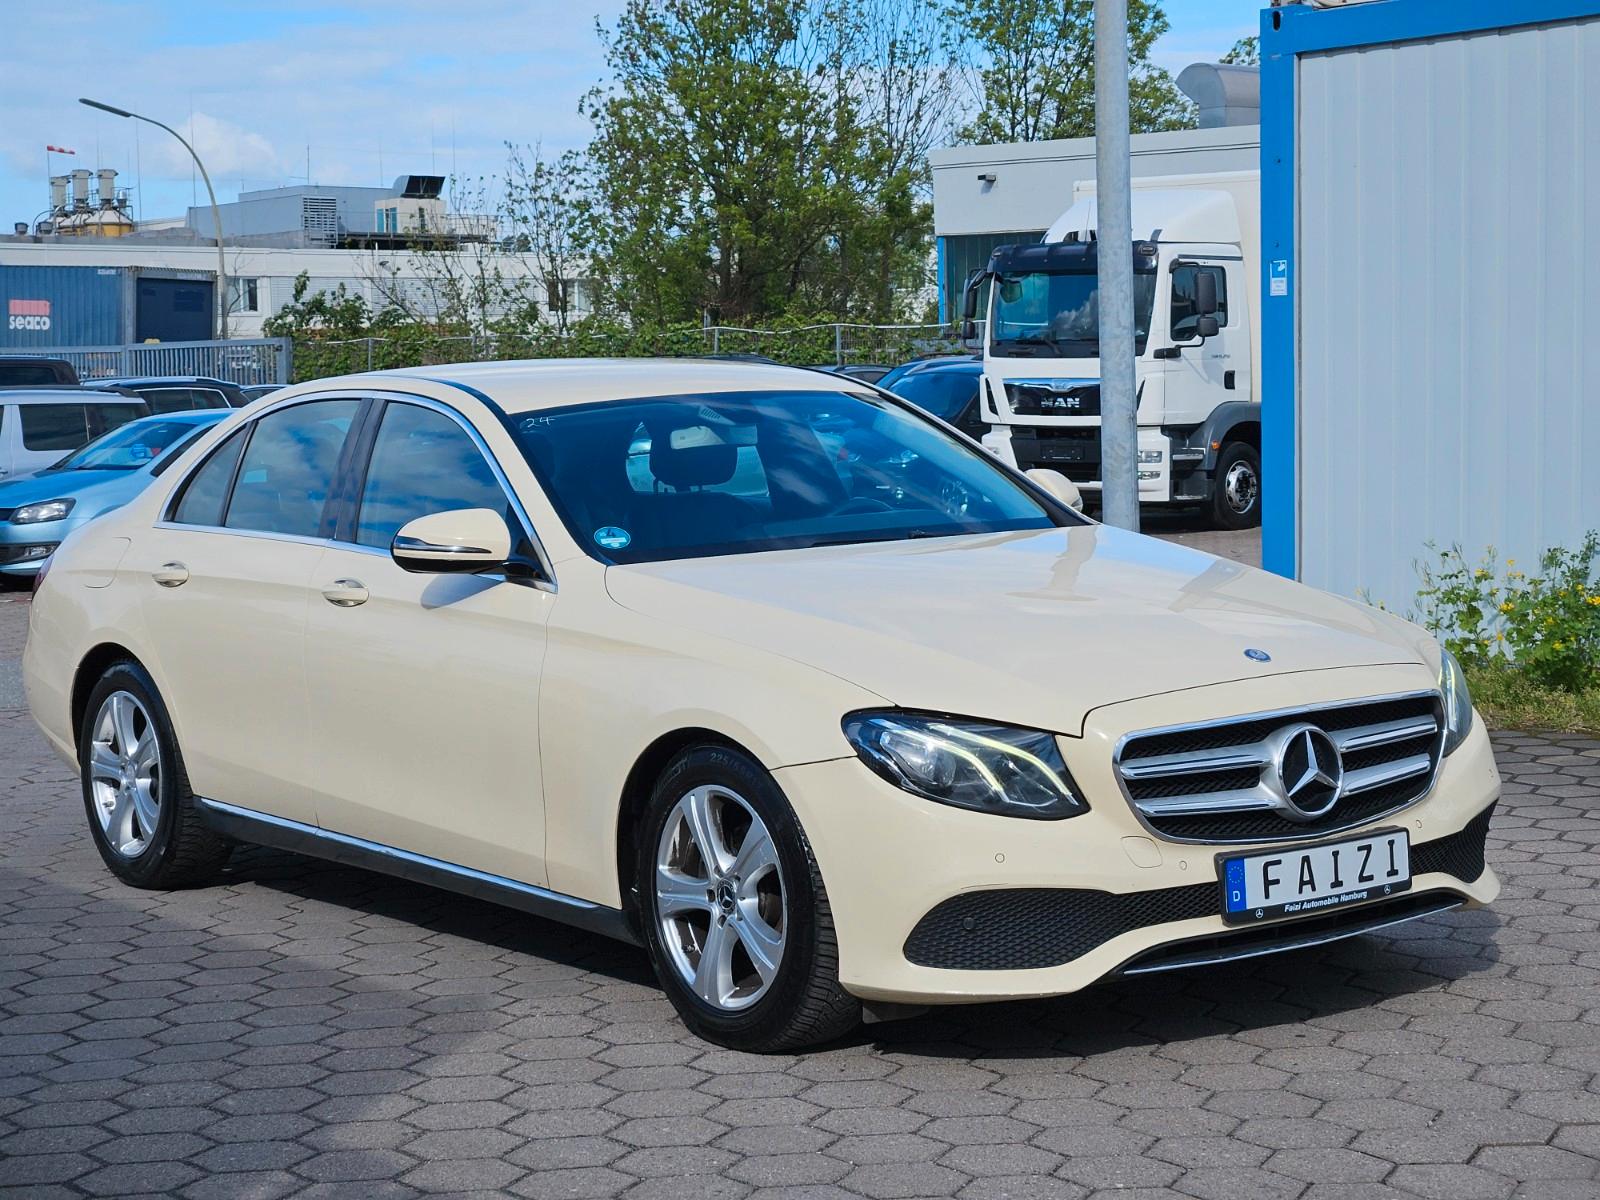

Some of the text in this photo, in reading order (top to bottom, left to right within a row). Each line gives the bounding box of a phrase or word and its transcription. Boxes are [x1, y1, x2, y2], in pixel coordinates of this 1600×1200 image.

[9, 315, 50, 330] seaco
[526, 416, 555, 428] 24
[1262, 839, 1399, 900] FAIZI
[1232, 890, 1241, 902] D
[1284, 891, 1368, 913] Faizi Automobile Hamburg
